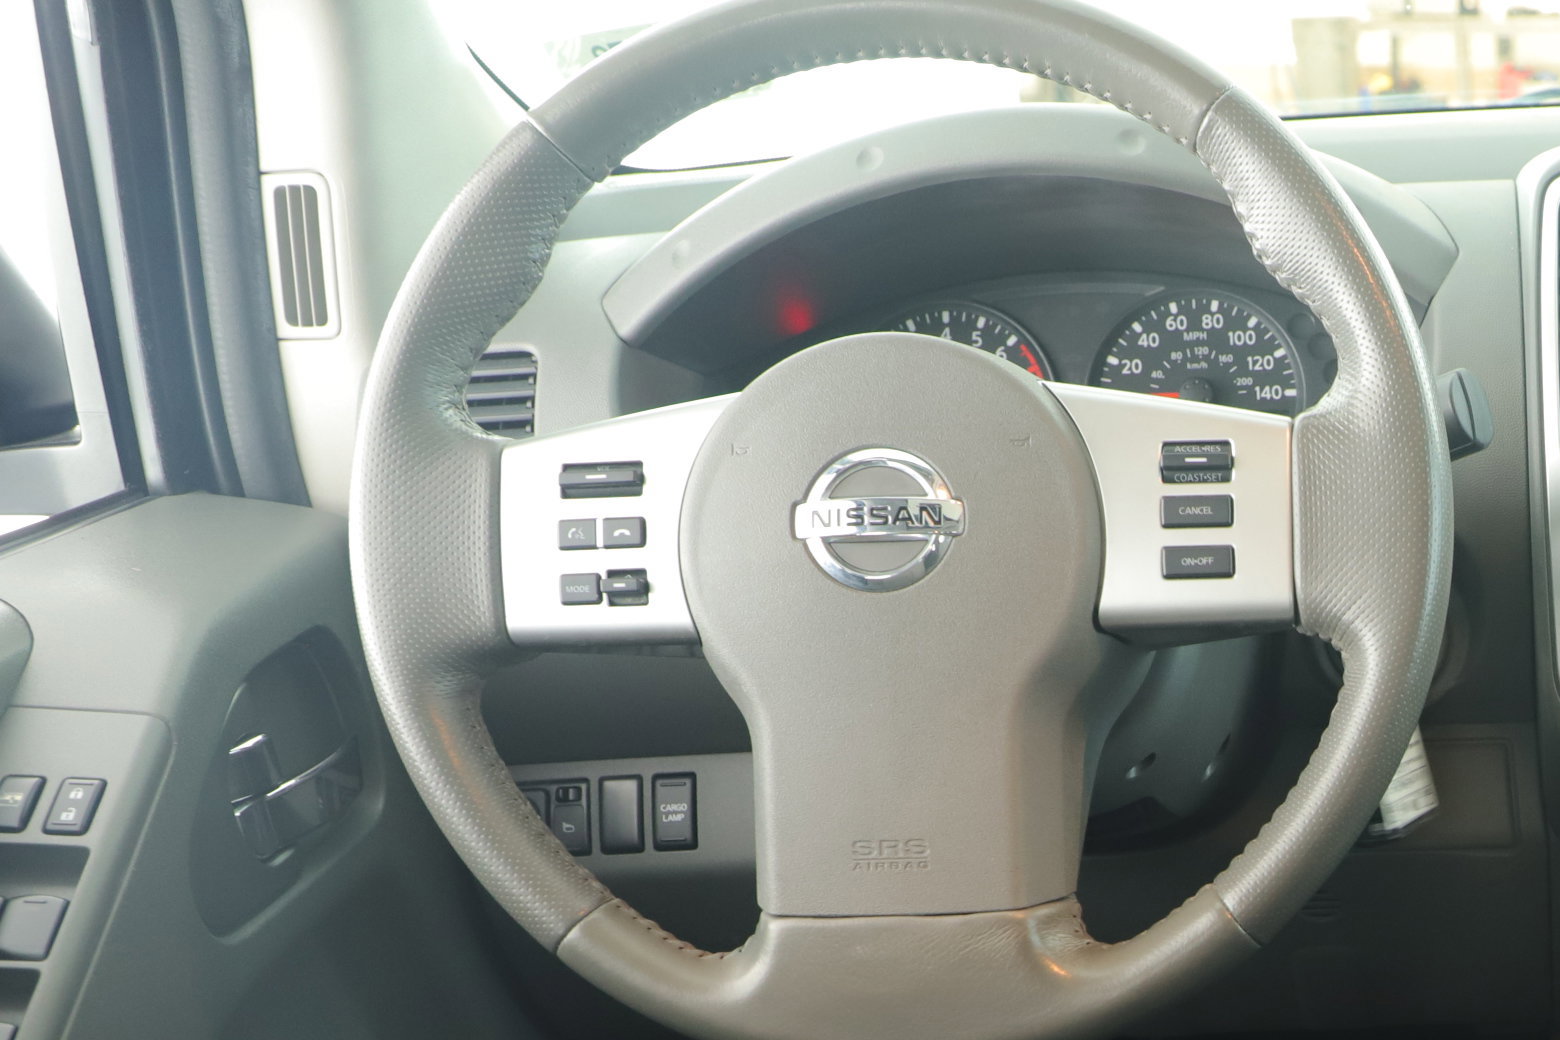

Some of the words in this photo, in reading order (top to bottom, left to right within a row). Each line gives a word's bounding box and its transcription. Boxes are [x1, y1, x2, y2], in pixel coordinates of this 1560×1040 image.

[1165, 315, 1187, 330] 60
[1201, 314, 1224, 329] 80
[972, 331, 983, 347] 5
[1138, 332, 1159, 347] 40
[1183, 331, 1207, 341] MPH
[1228, 330, 1256, 346] 100
[1194, 346, 1209, 355] 120
[1122, 359, 1143, 374] 20
[1187, 360, 1208, 370] km/h
[1247, 355, 1274, 371] 120
[1254, 385, 1282, 400] 140
[812, 503, 943, 528] NISSAN
[1178, 506, 1213, 515] CANCEL
[565, 585, 591, 594] MODE
[660, 803, 688, 813] CARGO
[662, 813, 685, 823] LAMP
[851, 838, 929, 857] SRS
